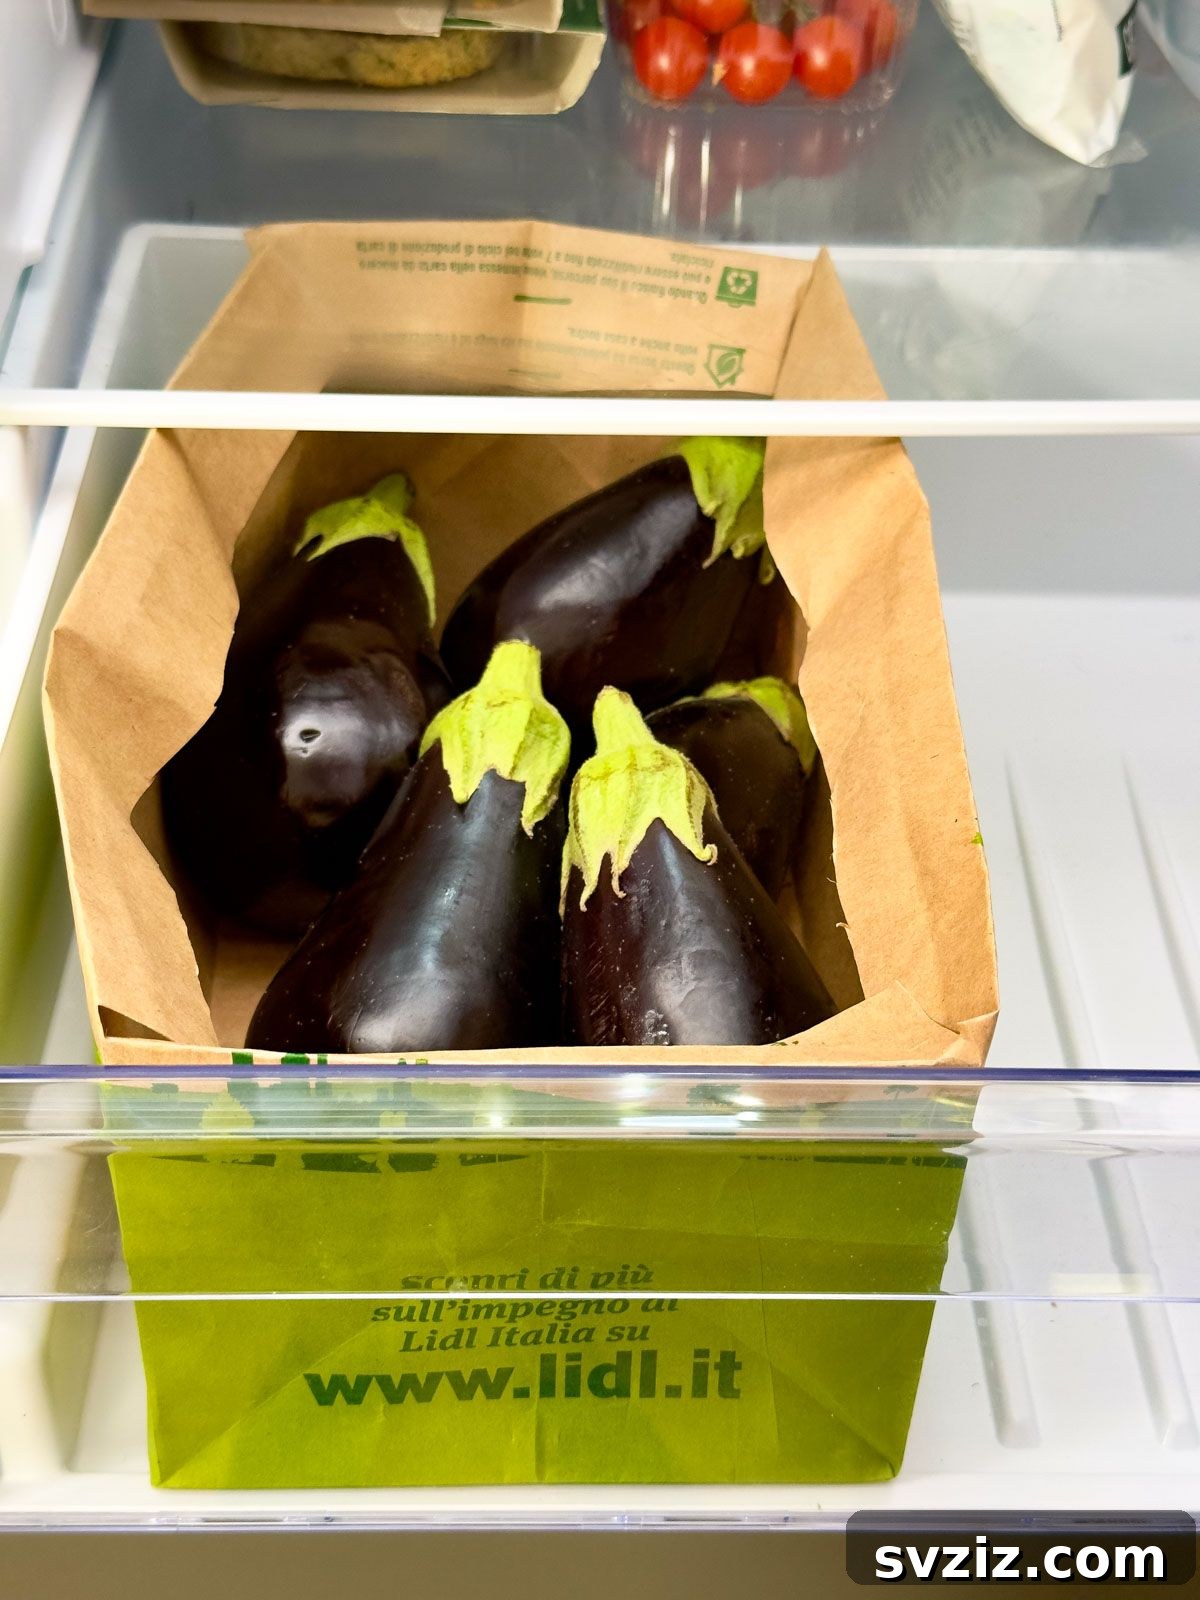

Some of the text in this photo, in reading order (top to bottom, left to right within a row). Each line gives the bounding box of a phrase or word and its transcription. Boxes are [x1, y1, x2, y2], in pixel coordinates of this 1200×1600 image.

[538, 1266, 580, 1290] di
[591, 1264, 654, 1292] più
[399, 1321, 651, 1353] Lidl Italia su
[303, 1347, 743, 1407] www.lidl.it
